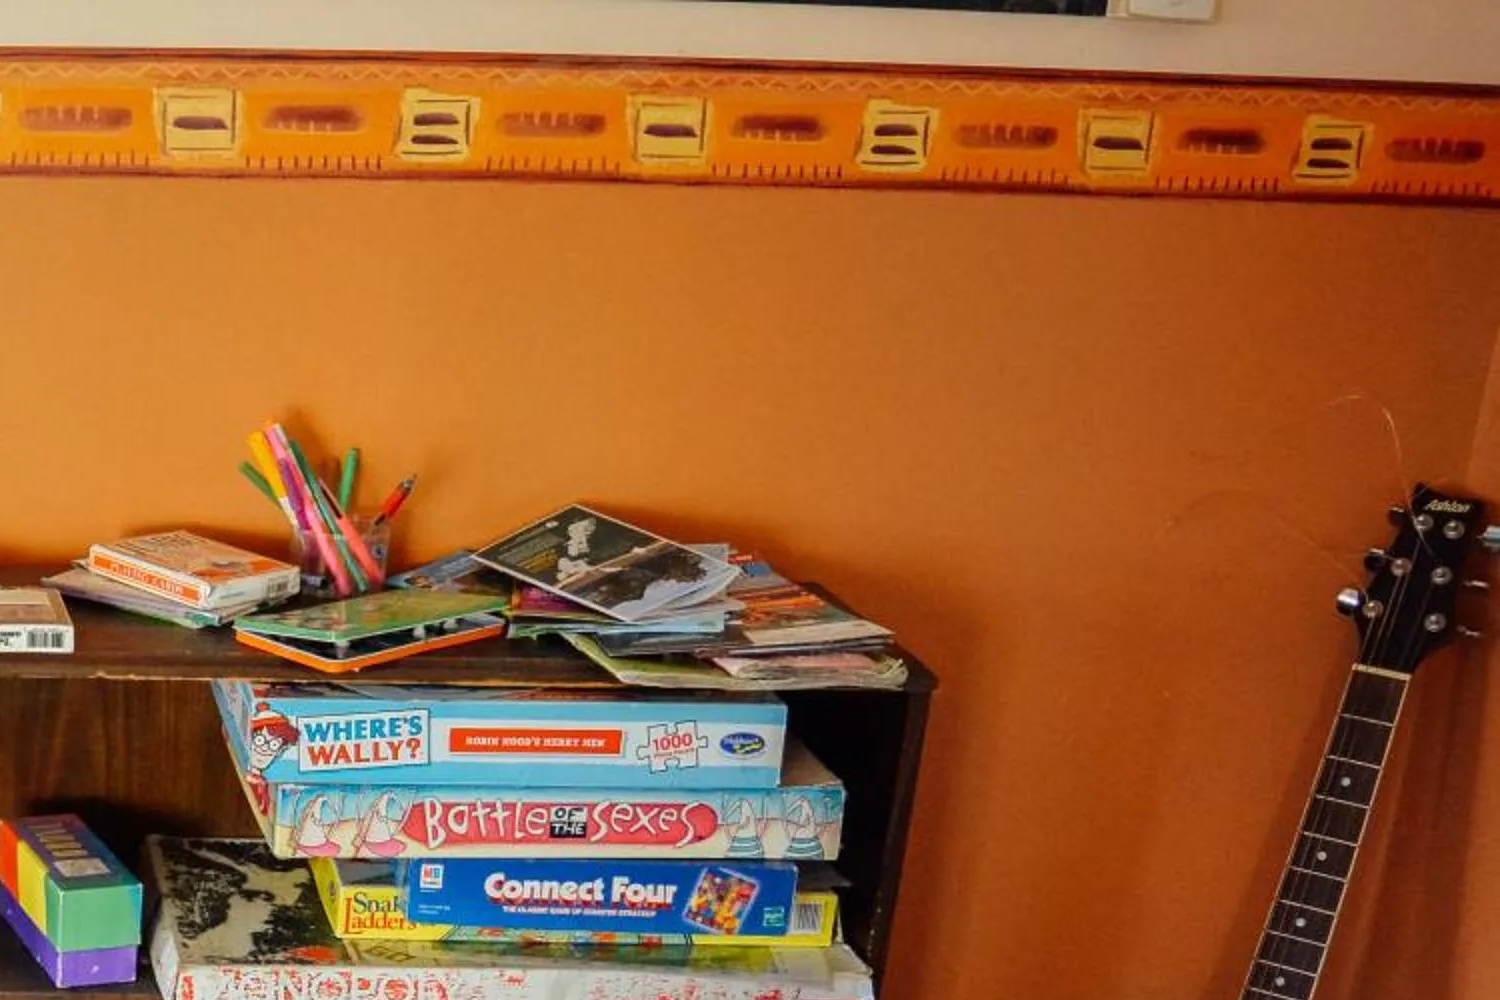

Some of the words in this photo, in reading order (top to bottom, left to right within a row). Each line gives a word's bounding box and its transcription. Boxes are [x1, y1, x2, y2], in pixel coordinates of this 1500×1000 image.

[303, 715, 423, 743] WHERE'S
[651, 732, 693, 751] 1000
[307, 737, 422, 767] WALLY?
[424, 797, 550, 849] Battle
[551, 823, 586, 836] THE
[553, 808, 576, 822] OF
[589, 800, 700, 849] Sexes
[483, 871, 606, 903] Connect
[611, 875, 679, 904] Four
[343, 897, 418, 935] Ladders
[353, 891, 399, 915] Sna
